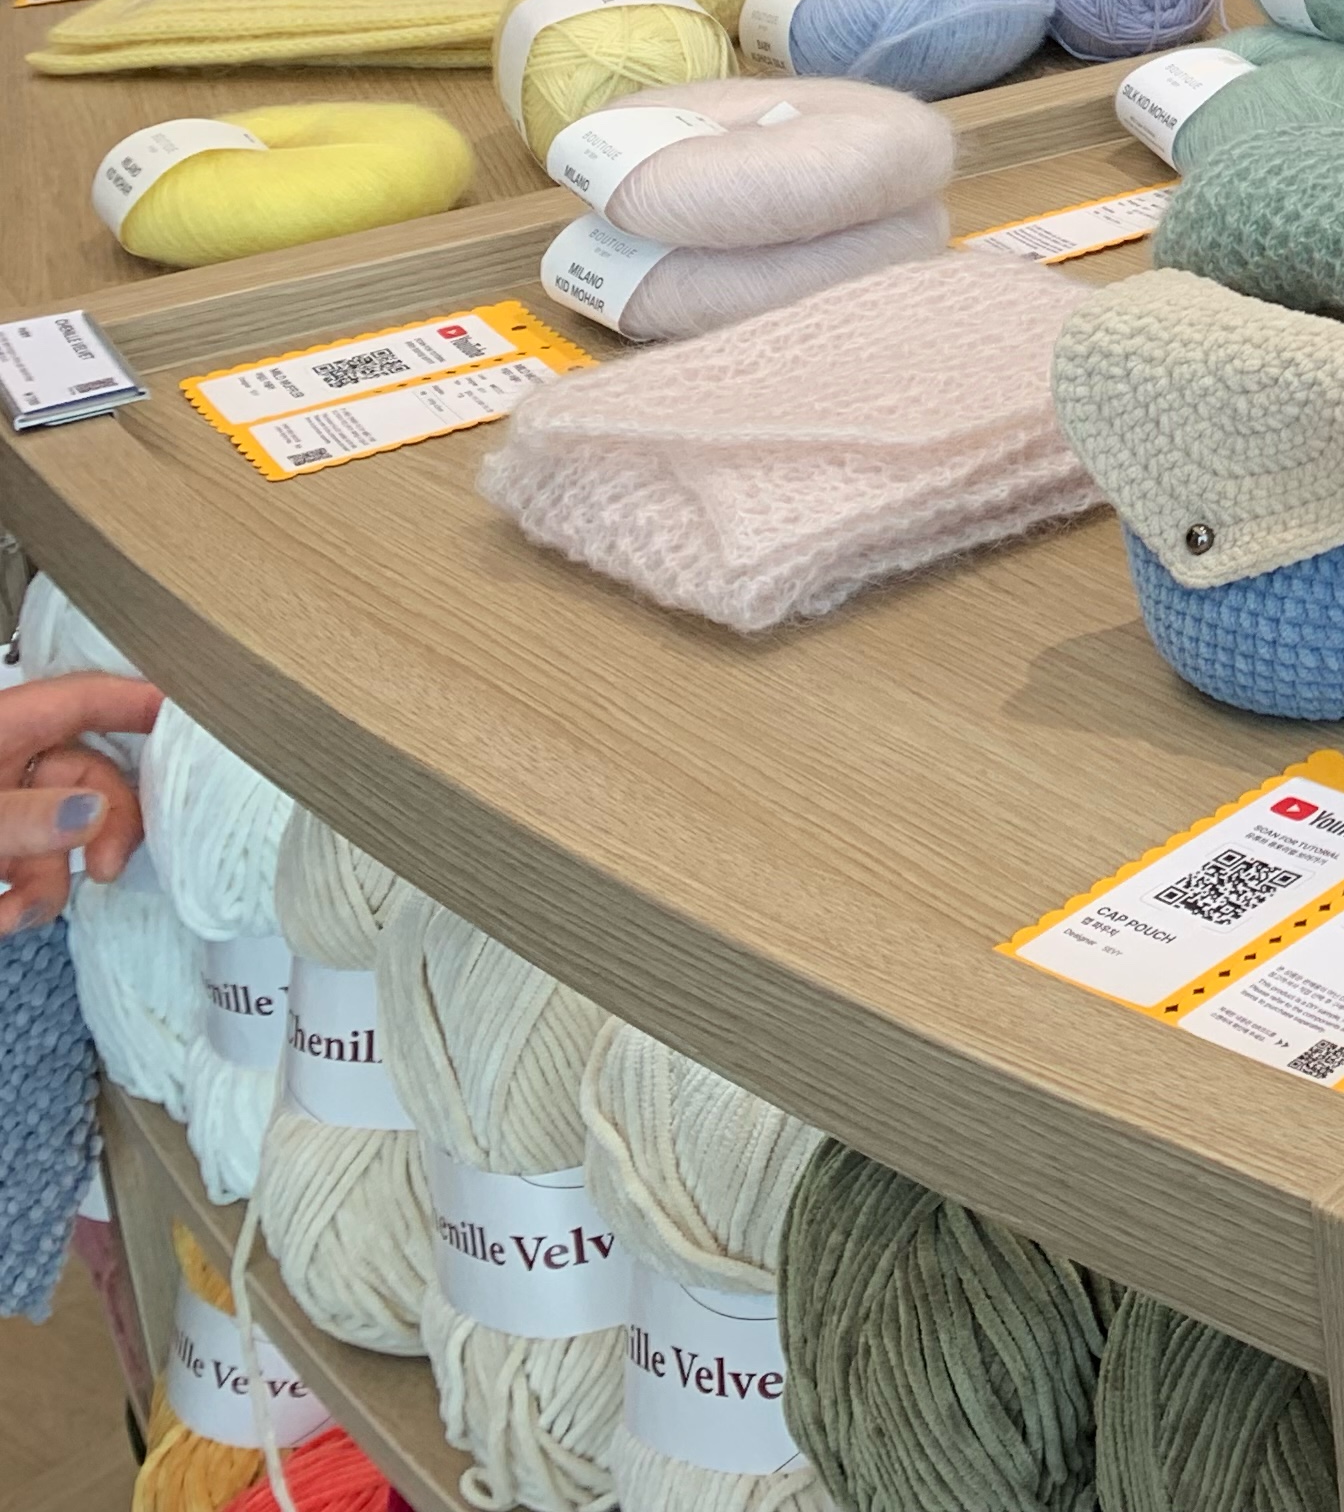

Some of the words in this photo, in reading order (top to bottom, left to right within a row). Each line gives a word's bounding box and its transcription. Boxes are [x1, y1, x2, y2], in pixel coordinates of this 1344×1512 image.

[1122, 83, 1139, 102] SILK
[1137, 93, 1151, 111] KID
[1149, 100, 1178, 131] MOHAIR
[581, 131, 623, 161] BOUTIQUE
[564, 165, 590, 193] MILANO
[589, 228, 638, 259] BOUTIQUE
[568, 262, 604, 289] MILANO
[555, 275, 570, 293] KID
[571, 285, 605, 313] MOHAIR
[1254, 825, 1280, 838] SCAN
[1278, 835, 1299, 846] FOR
[1298, 842, 1339, 860] TUTORIAL
[1063, 928, 1097, 946] Designer
[1101, 945, 1123, 956] SEVY
[1097, 907, 1129, 922] CAP
[1124, 919, 1176, 944] POUCH
[509, 1227, 615, 1271] Velv
[211, 1359, 308, 1398] Veve
[671, 1345, 784, 1400] Velve
